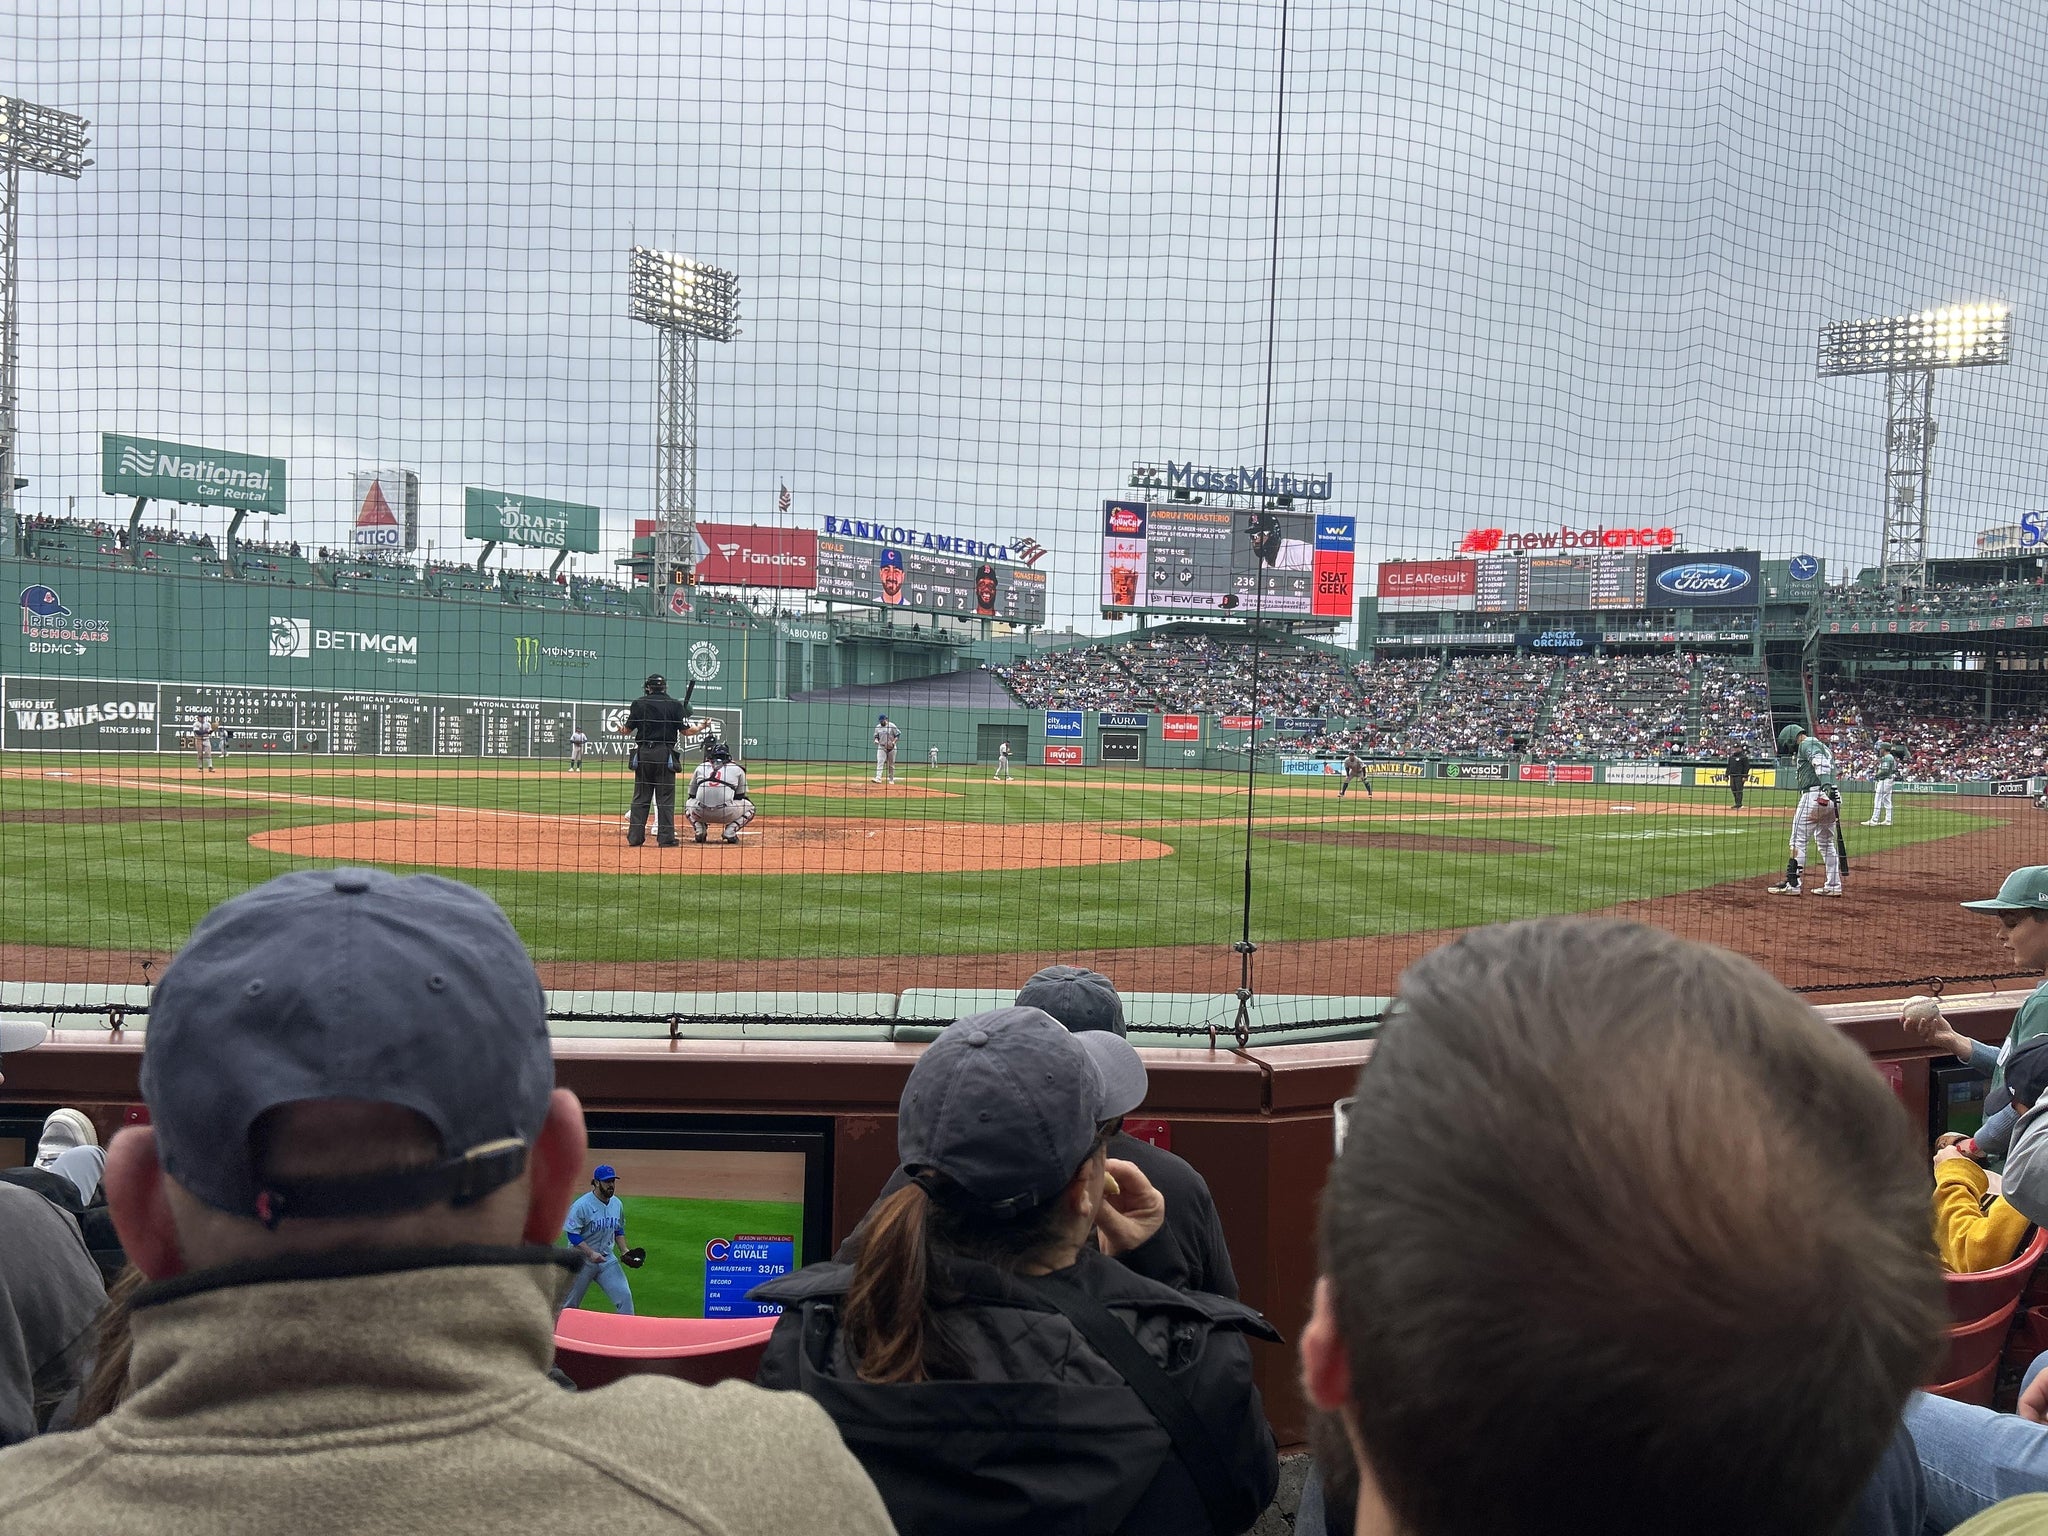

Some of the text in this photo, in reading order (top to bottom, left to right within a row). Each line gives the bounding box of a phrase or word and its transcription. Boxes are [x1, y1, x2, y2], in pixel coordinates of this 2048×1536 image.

[157, 454, 271, 490] National
[1167, 460, 1333, 500] MassMutual
[197, 484, 267, 503] Car Rental
[500, 511, 569, 532] DRAFT
[1183, 512, 1230, 523] MONASTERIO
[355, 527, 398, 546] CITGO
[507, 527, 566, 546] KINGS
[824, 515, 1008, 561] BANK OF AMERICA
[1507, 524, 1674, 550] new balance
[820, 541, 845, 553] CIVALE
[742, 548, 807, 567] Fanatics
[1180, 557, 1193, 565] 4TH
[1154, 570, 1192, 582] P6 DP
[1320, 571, 1348, 583] SEAT
[1388, 572, 1466, 585] CLEAResult
[1675, 569, 1734, 590] Ford
[1233, 577, 1305, 589] .236 6 42
[955, 588, 968, 596] OUTS
[1319, 583, 1348, 596] GEEK
[916, 592, 964, 609] 0 0 2
[29, 615, 110, 632] RED SOX
[29, 628, 110, 643] SCHOLARS
[788, 627, 829, 641] ABIOMED
[1540, 631, 1577, 639] ANGRY
[315, 629, 418, 656] BETMGM
[689, 640, 709, 654] IBEW
[1532, 639, 1584, 647] ORCHARD
[29, 642, 73, 656] BIDMC
[541, 645, 598, 660] MONSTER
[196, 688, 298, 700] FENWAY PARK
[342, 694, 420, 704] AMERICAN LEAGUE
[8, 700, 56, 709] WHO BUT
[184, 706, 213, 714] CHICAGO
[473, 701, 509, 709] NATIONAL
[184, 714, 212, 723] BOSN
[1047, 717, 1060, 726] city
[99, 726, 152, 735] SINCE 1898
[395, 726, 408, 734] TEX
[1047, 723, 1072, 731] cruises
[1164, 722, 1198, 731] Safelite
[232, 731, 258, 740] STRIKE
[584, 741, 609, 756] F.W.
[1184, 749, 1196, 757] 420
[1049, 751, 1077, 760] IRVING
[1285, 760, 1319, 772] jetBlue
[1402, 763, 1424, 776] CITY
[1461, 765, 1501, 775] wasabi
[733, 1250, 768, 1260] CIVALE
[710, 1264, 785, 1275] GAMES/STARTS 33/15
[757, 1304, 783, 1315] 109.0
